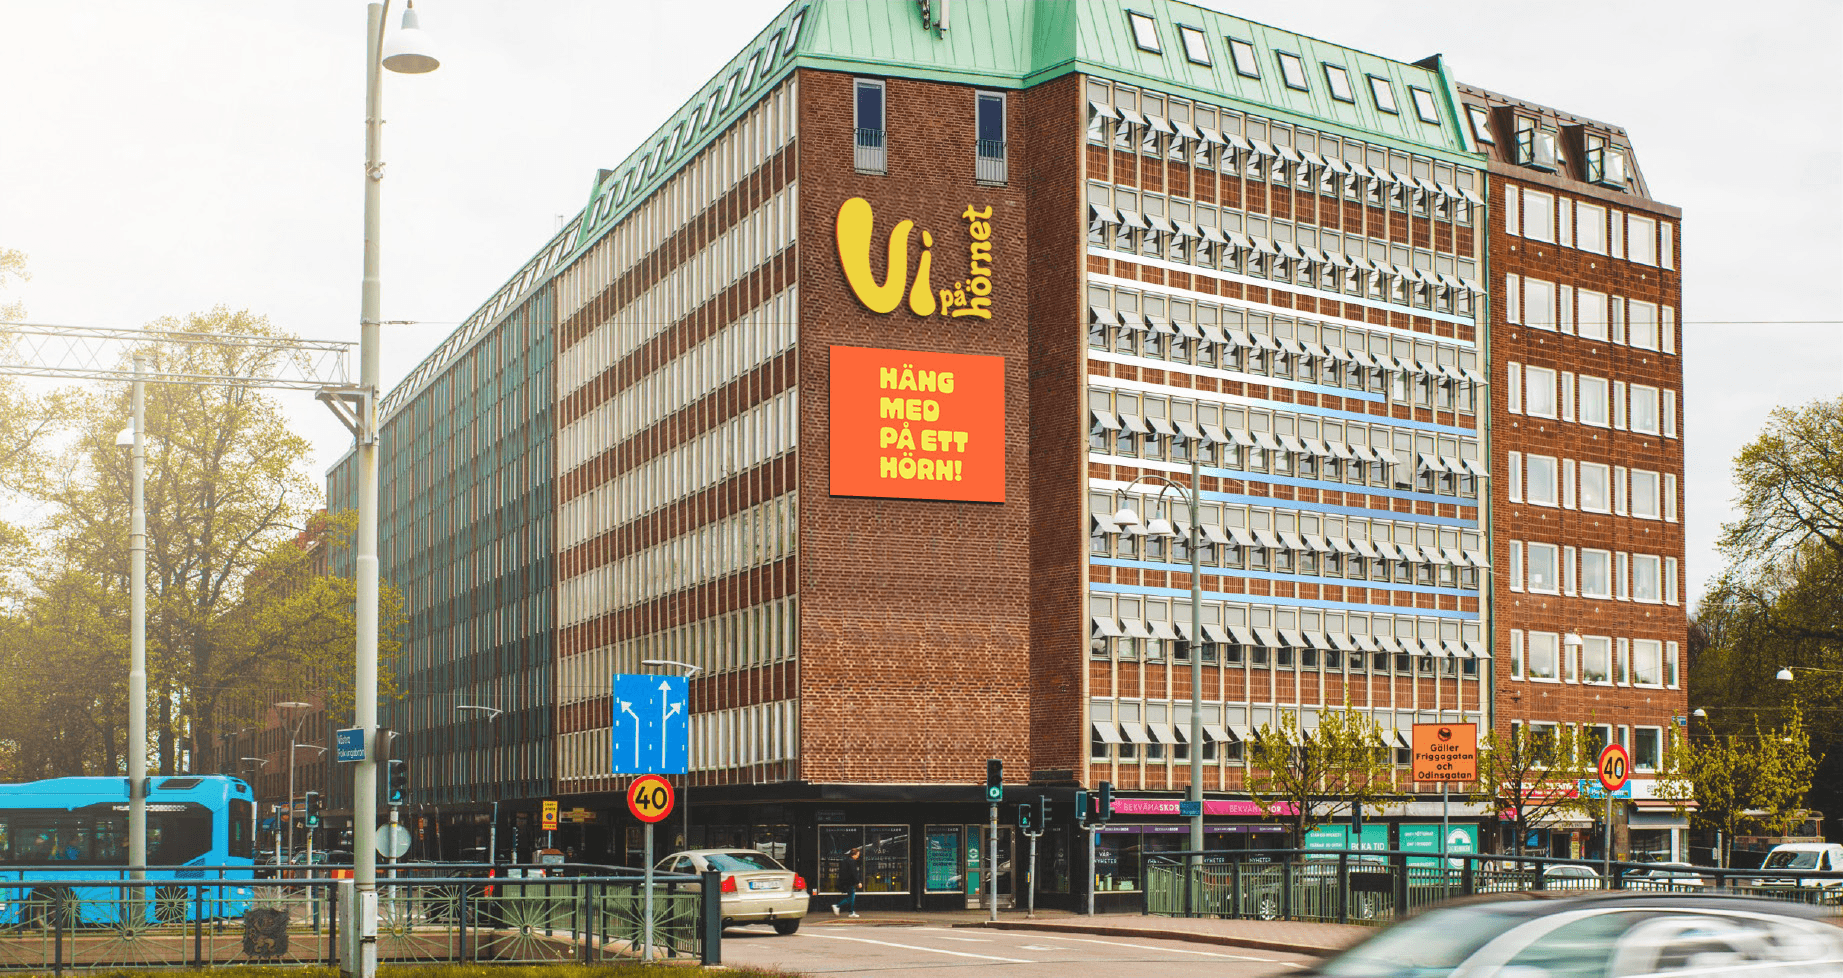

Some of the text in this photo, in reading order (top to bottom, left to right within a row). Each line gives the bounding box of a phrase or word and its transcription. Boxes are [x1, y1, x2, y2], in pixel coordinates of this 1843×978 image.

[952, 204, 993, 319] hörnet
[939, 281, 968, 316] på
[879, 363, 954, 394] HÄNG
[879, 397, 940, 422] MED
[879, 421, 969, 453] PÅ ETT
[879, 451, 963, 482] HÖRN!
[1416, 753, 1474, 761] Friggagatan
[1430, 744, 1459, 752] Gäller
[1418, 771, 1472, 779] Odinsgatan
[1436, 762, 1453, 770] och
[1603, 756, 1624, 779] 40
[635, 786, 668, 810] 40
